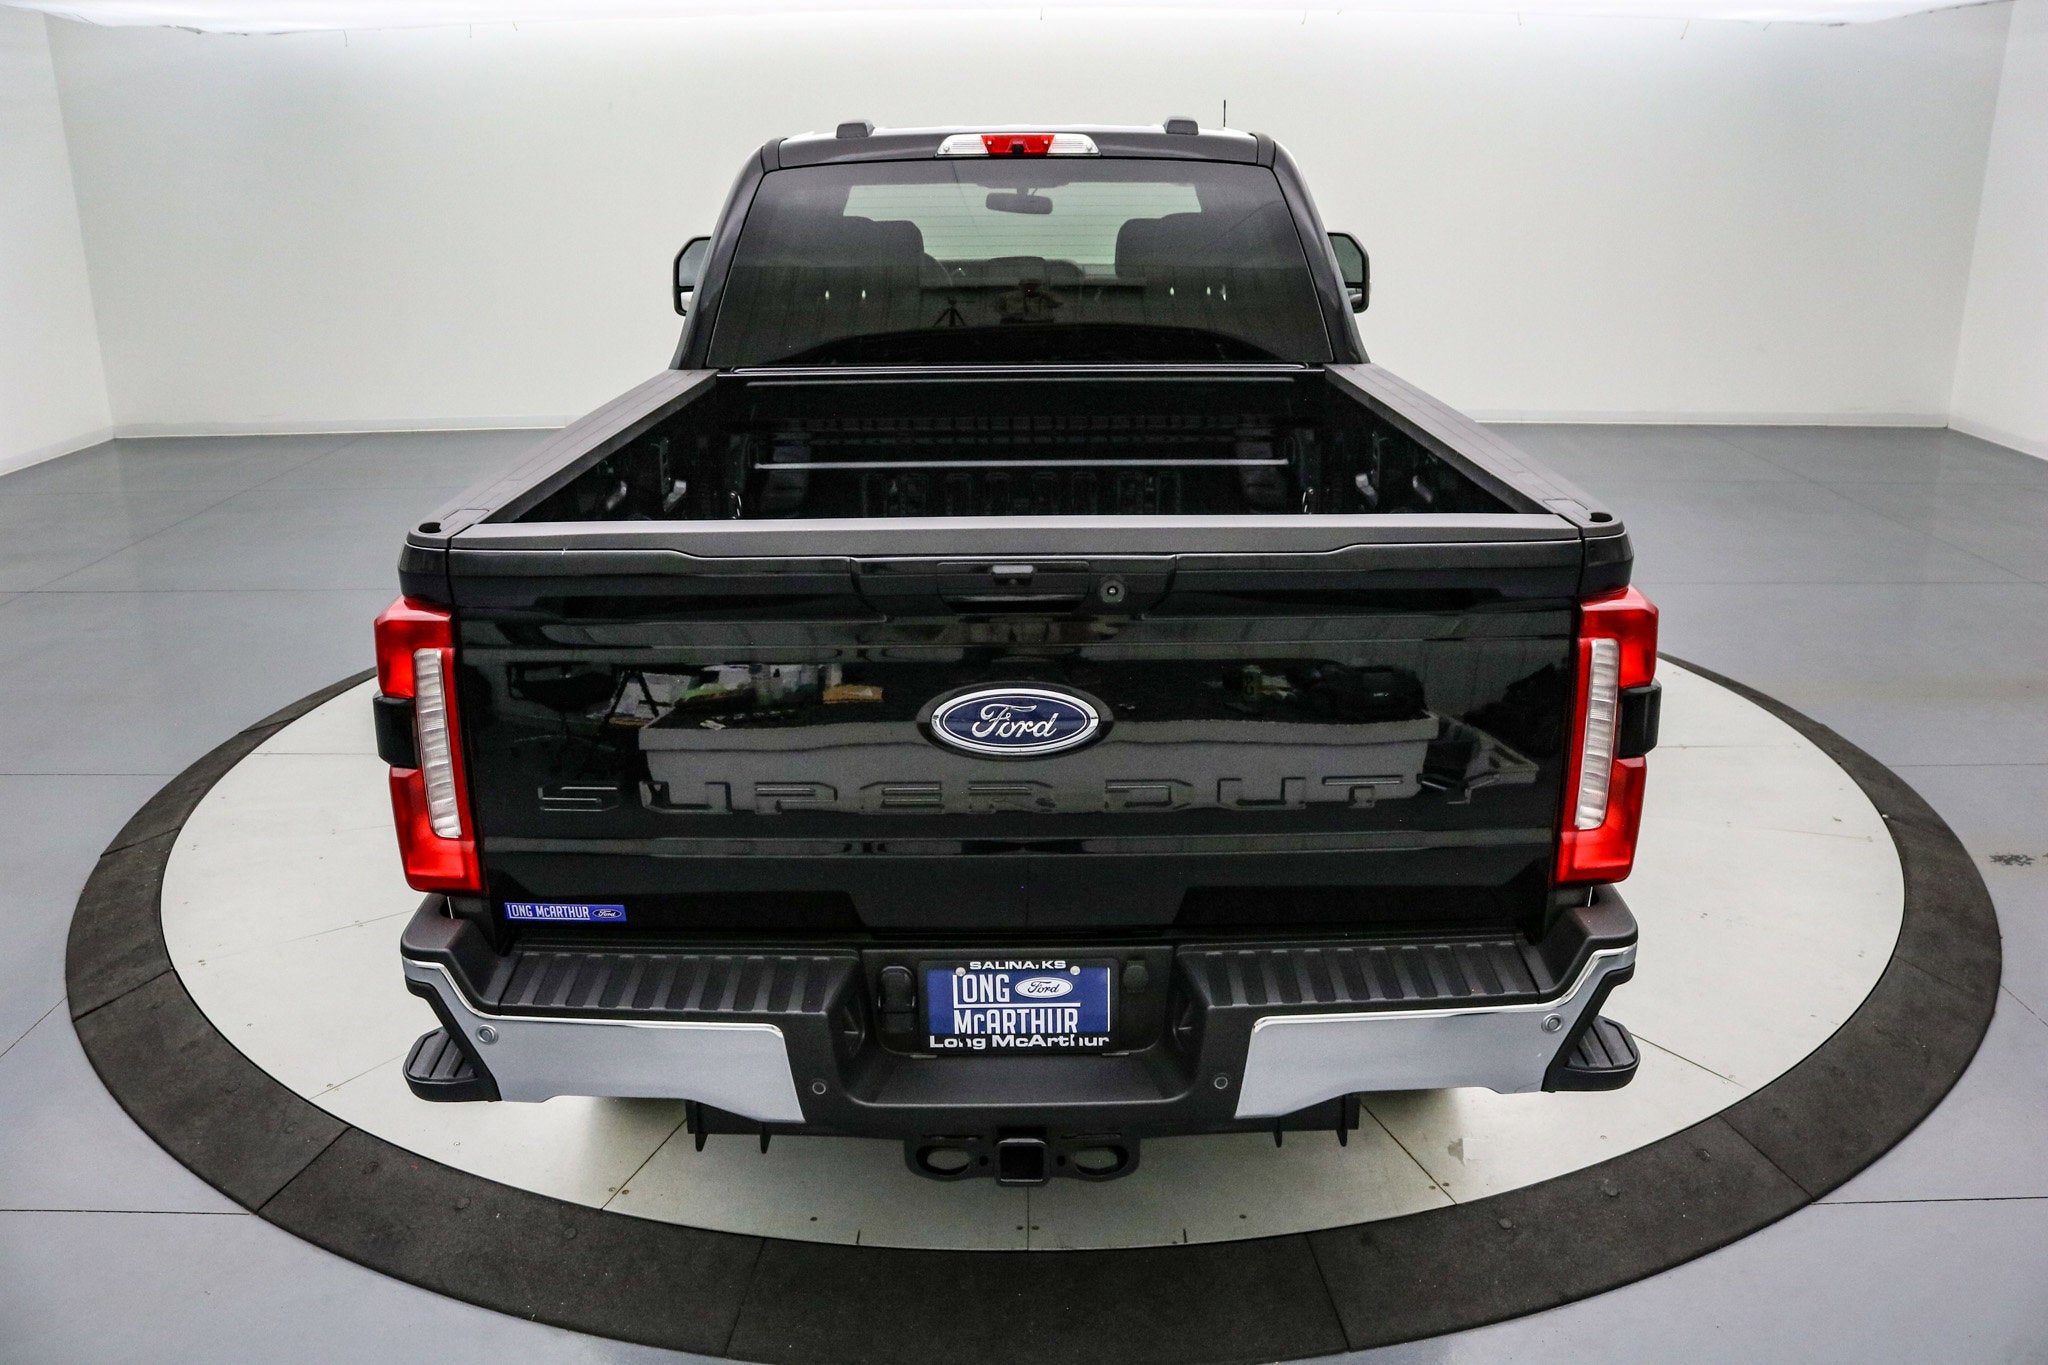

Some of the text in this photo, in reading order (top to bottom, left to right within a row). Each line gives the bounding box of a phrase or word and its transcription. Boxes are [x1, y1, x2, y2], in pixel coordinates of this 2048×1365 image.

[971, 703, 1058, 738] Ford
[507, 905, 533, 918] LONG
[535, 906, 590, 918] McARTHUR
[1042, 960, 1067, 970] KS
[952, 974, 1010, 1005] LONG
[953, 1008, 1079, 1035] McARTHUR
